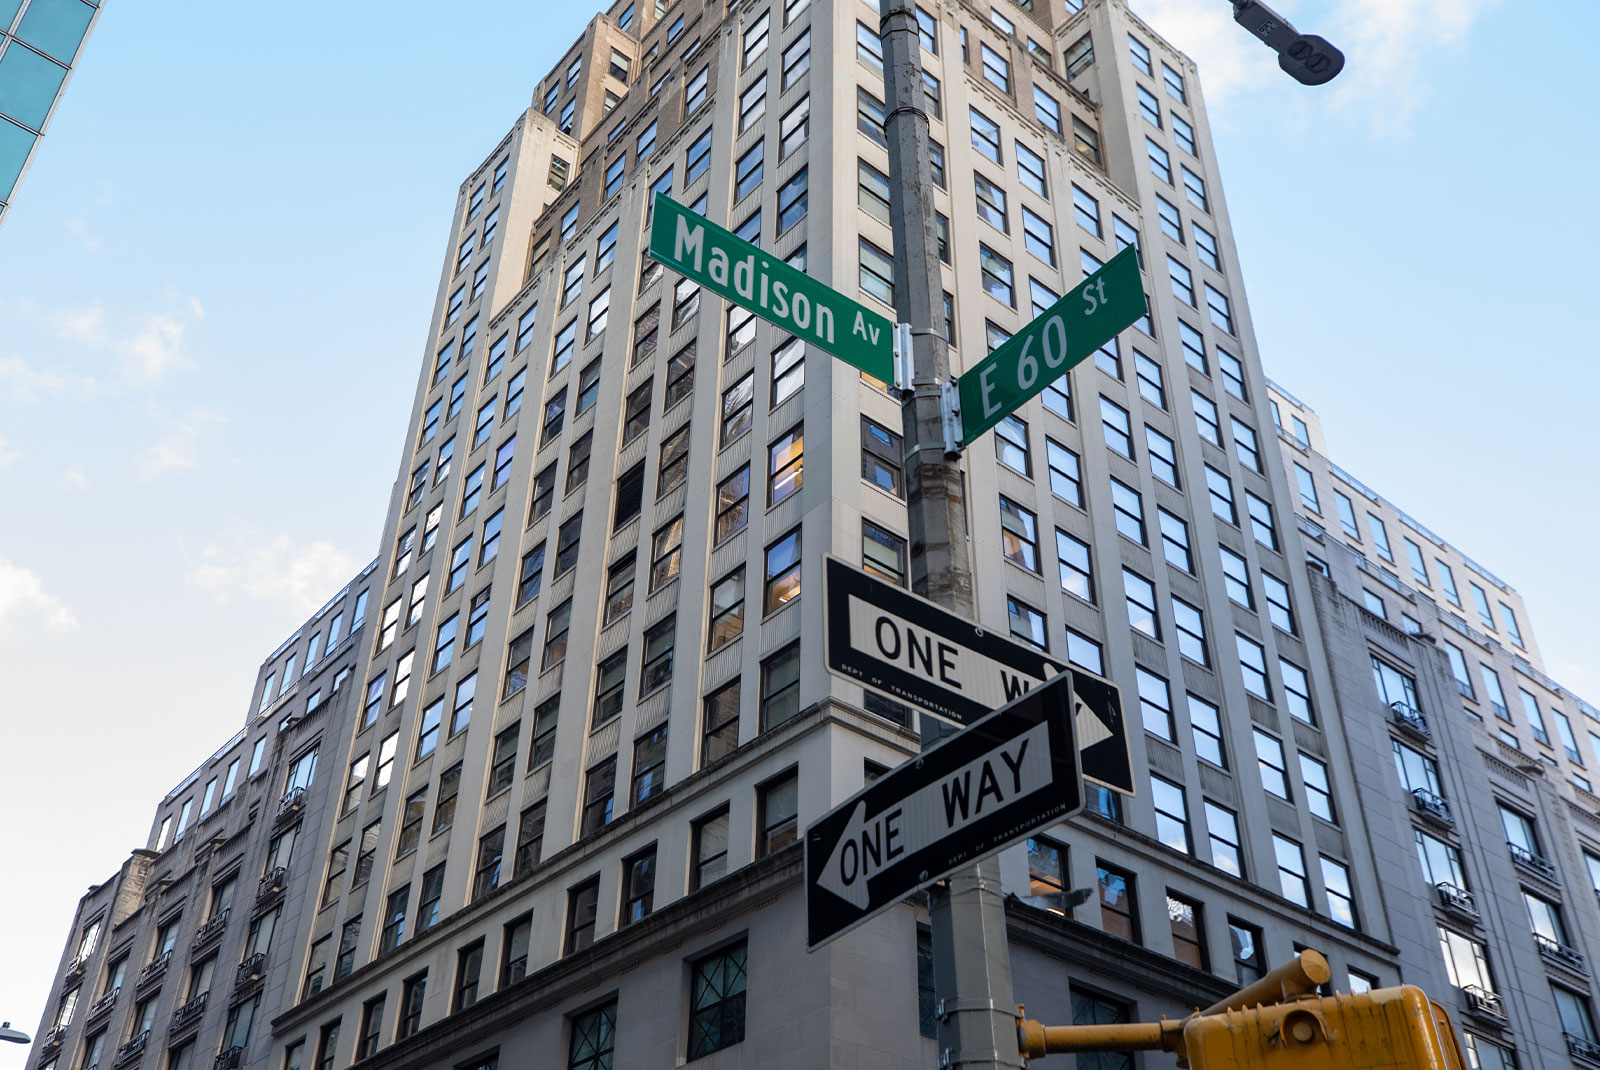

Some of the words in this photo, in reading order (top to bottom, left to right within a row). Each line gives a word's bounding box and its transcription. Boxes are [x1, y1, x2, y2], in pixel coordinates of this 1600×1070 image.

[674, 214, 835, 344] Madison
[852, 311, 880, 345] Av
[979, 362, 1002, 420] E
[1017, 315, 1067, 390] 60
[1082, 276, 1108, 315] St
[841, 663, 863, 677] DEPT
[872, 677, 882, 685] OF
[890, 685, 962, 720] TRANSPORTATION
[875, 616, 962, 690] ONE
[840, 807, 904, 887] ONE
[942, 738, 1030, 828] WAY
[993, 802, 1066, 842] TRANSPORTATION
